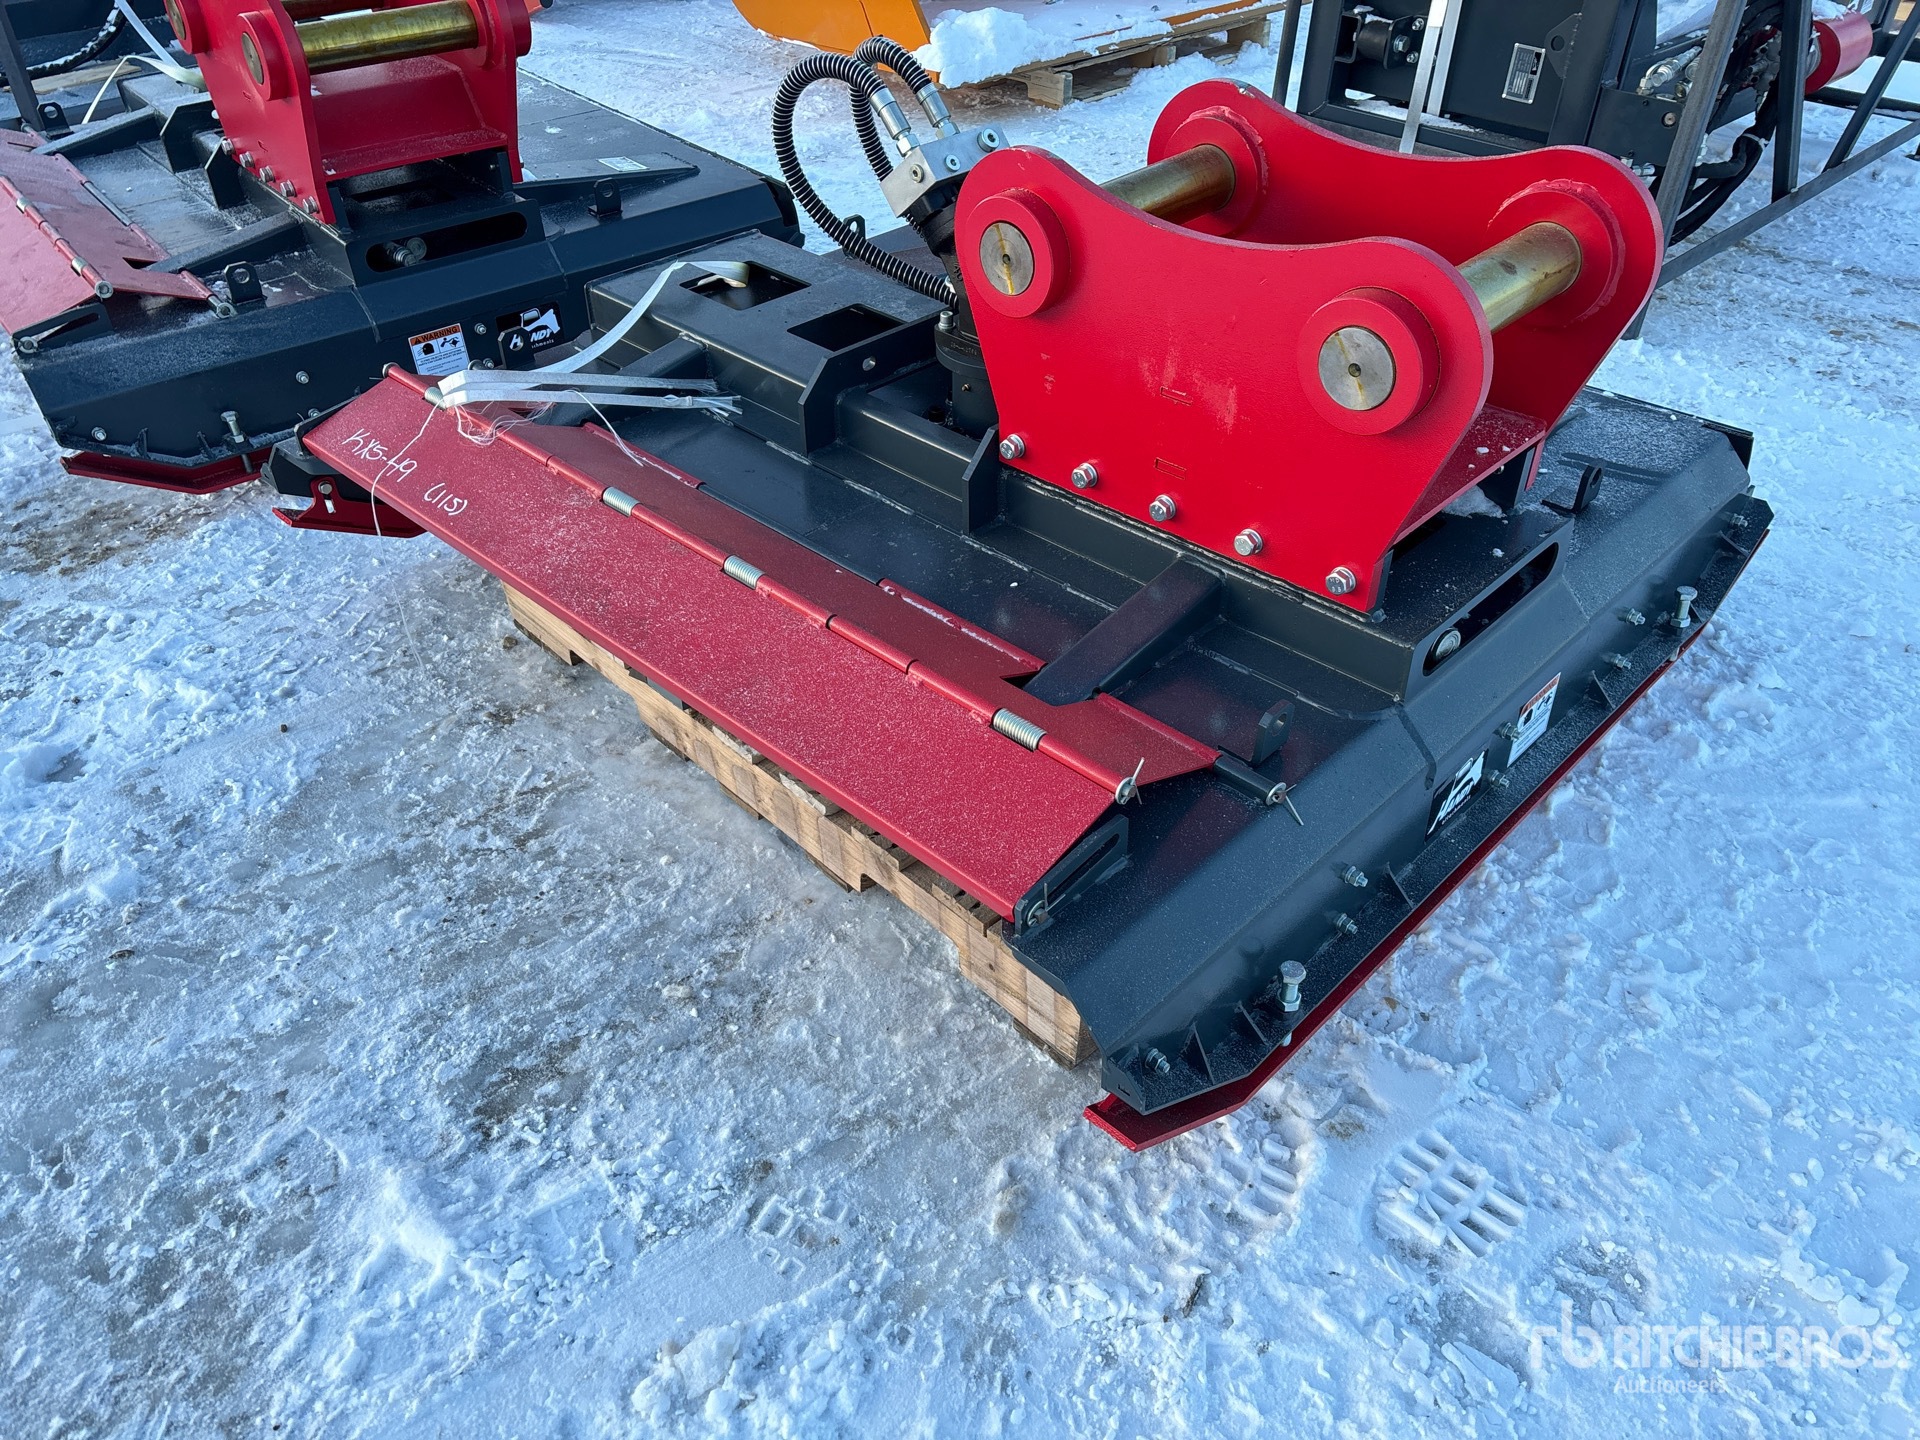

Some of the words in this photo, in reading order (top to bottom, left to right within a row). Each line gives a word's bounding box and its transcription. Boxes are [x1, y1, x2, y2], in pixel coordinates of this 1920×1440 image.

[420, 326, 458, 342] WARNING
[510, 328, 553, 350] HNDY
[424, 482, 467, 516] (115)
